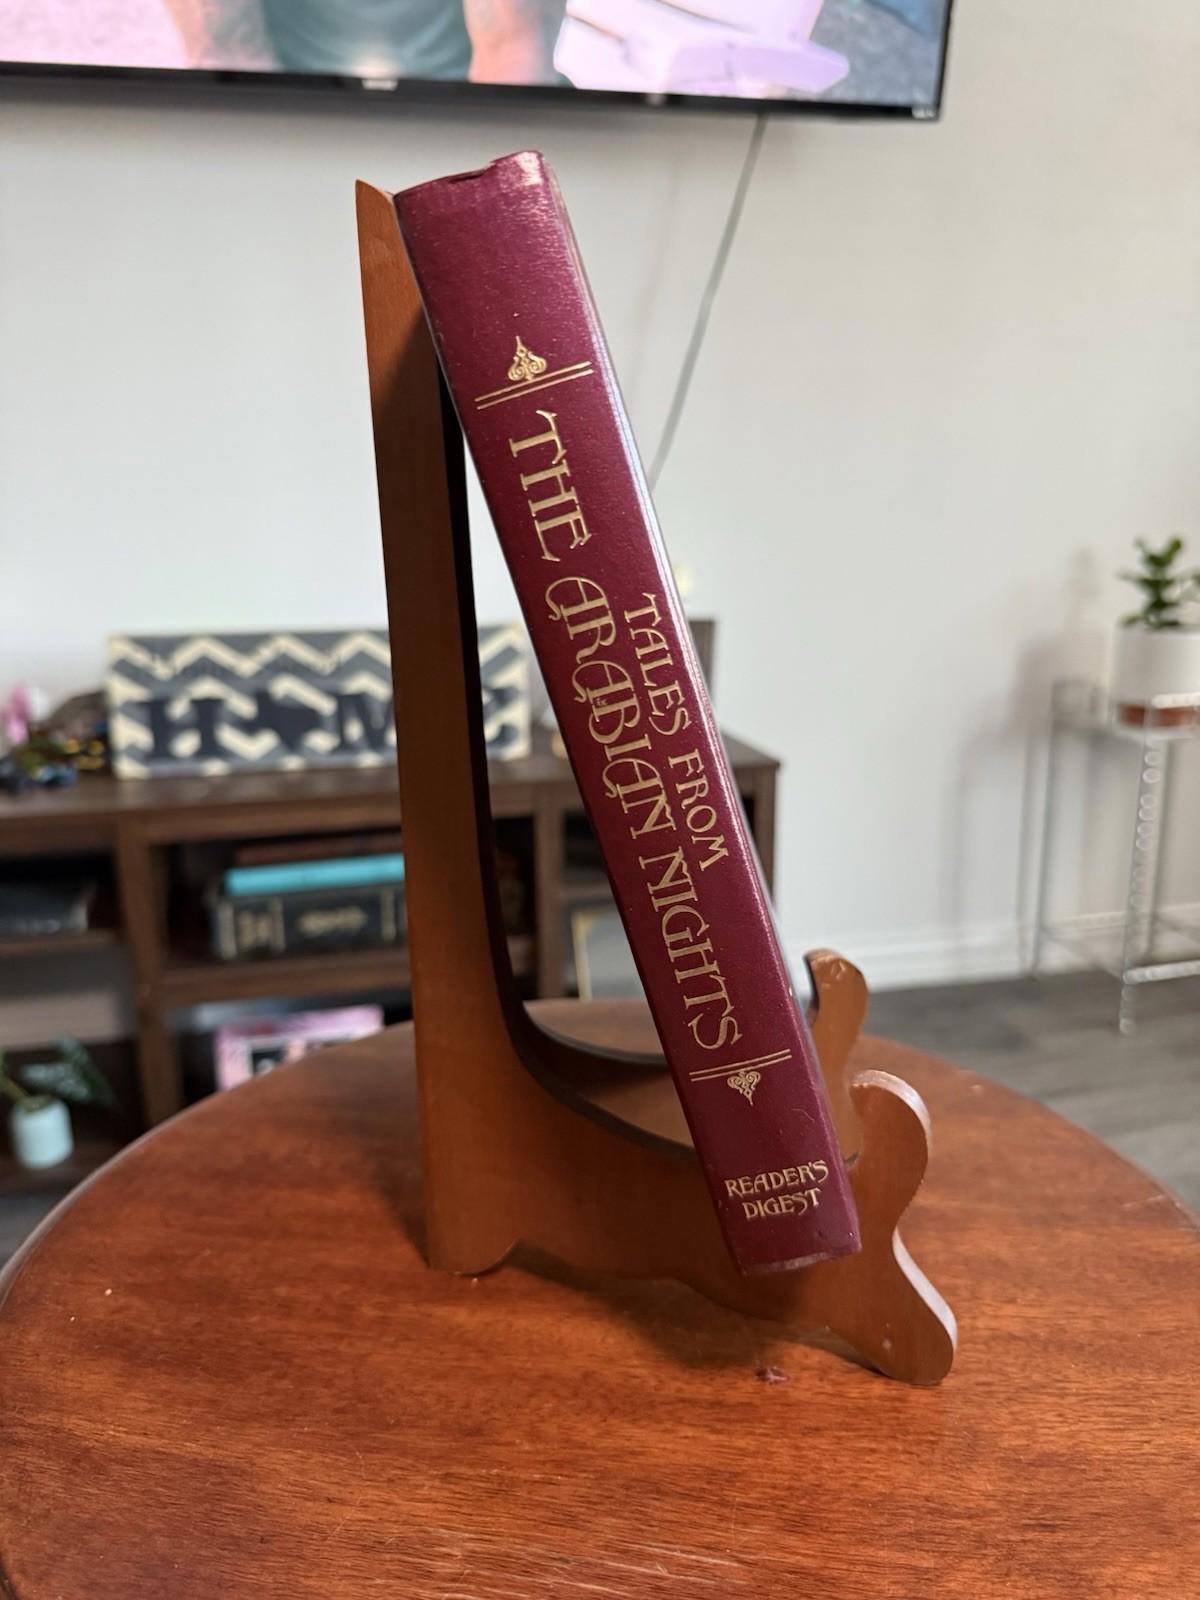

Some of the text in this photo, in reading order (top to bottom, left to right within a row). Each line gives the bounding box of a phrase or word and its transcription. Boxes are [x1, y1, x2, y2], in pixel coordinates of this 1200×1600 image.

[509, 410, 743, 1051] THE ARABIAN NIGHTS
[623, 592, 729, 872] TALES FROM
[724, 1159, 829, 1198] READER'S
[742, 1187, 821, 1220] DIGEST
